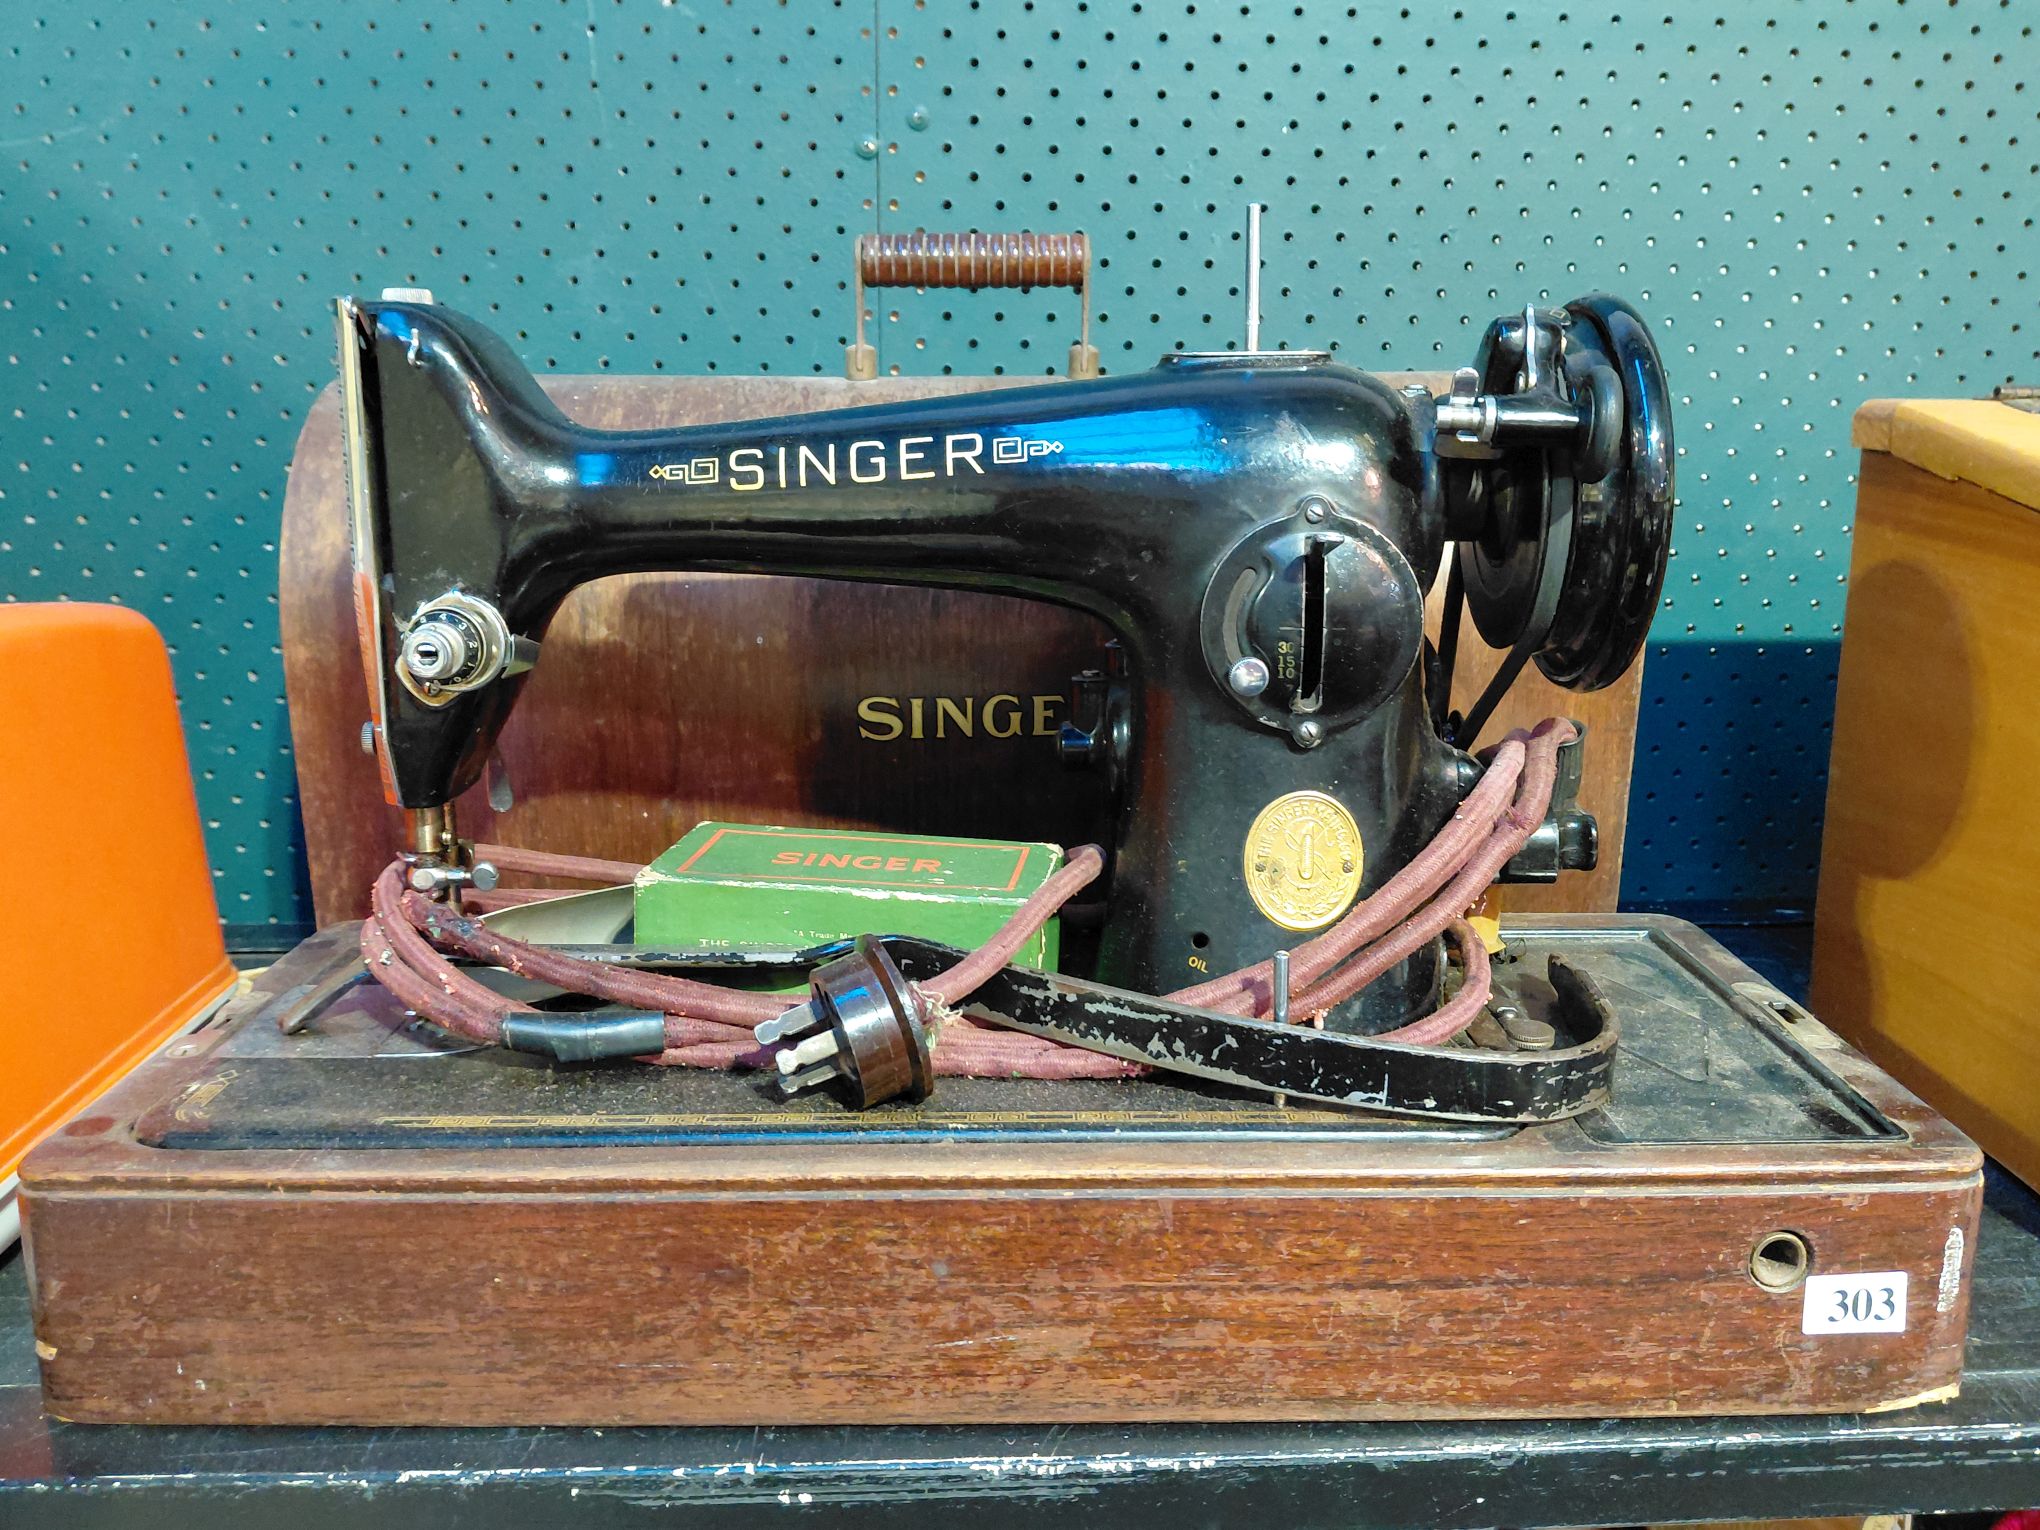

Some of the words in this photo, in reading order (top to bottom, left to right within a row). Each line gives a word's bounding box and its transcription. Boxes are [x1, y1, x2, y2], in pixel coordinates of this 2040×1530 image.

[728, 433, 985, 491] SINGER
[1278, 641, 1295, 653] 30
[1278, 656, 1295, 667] 15
[1278, 668, 1295, 678] 10
[857, 694, 1065, 741] SINGE
[771, 851, 942, 874] SINGER
[1188, 956, 1208, 974] OIL
[1827, 1287, 1896, 1323] 303
